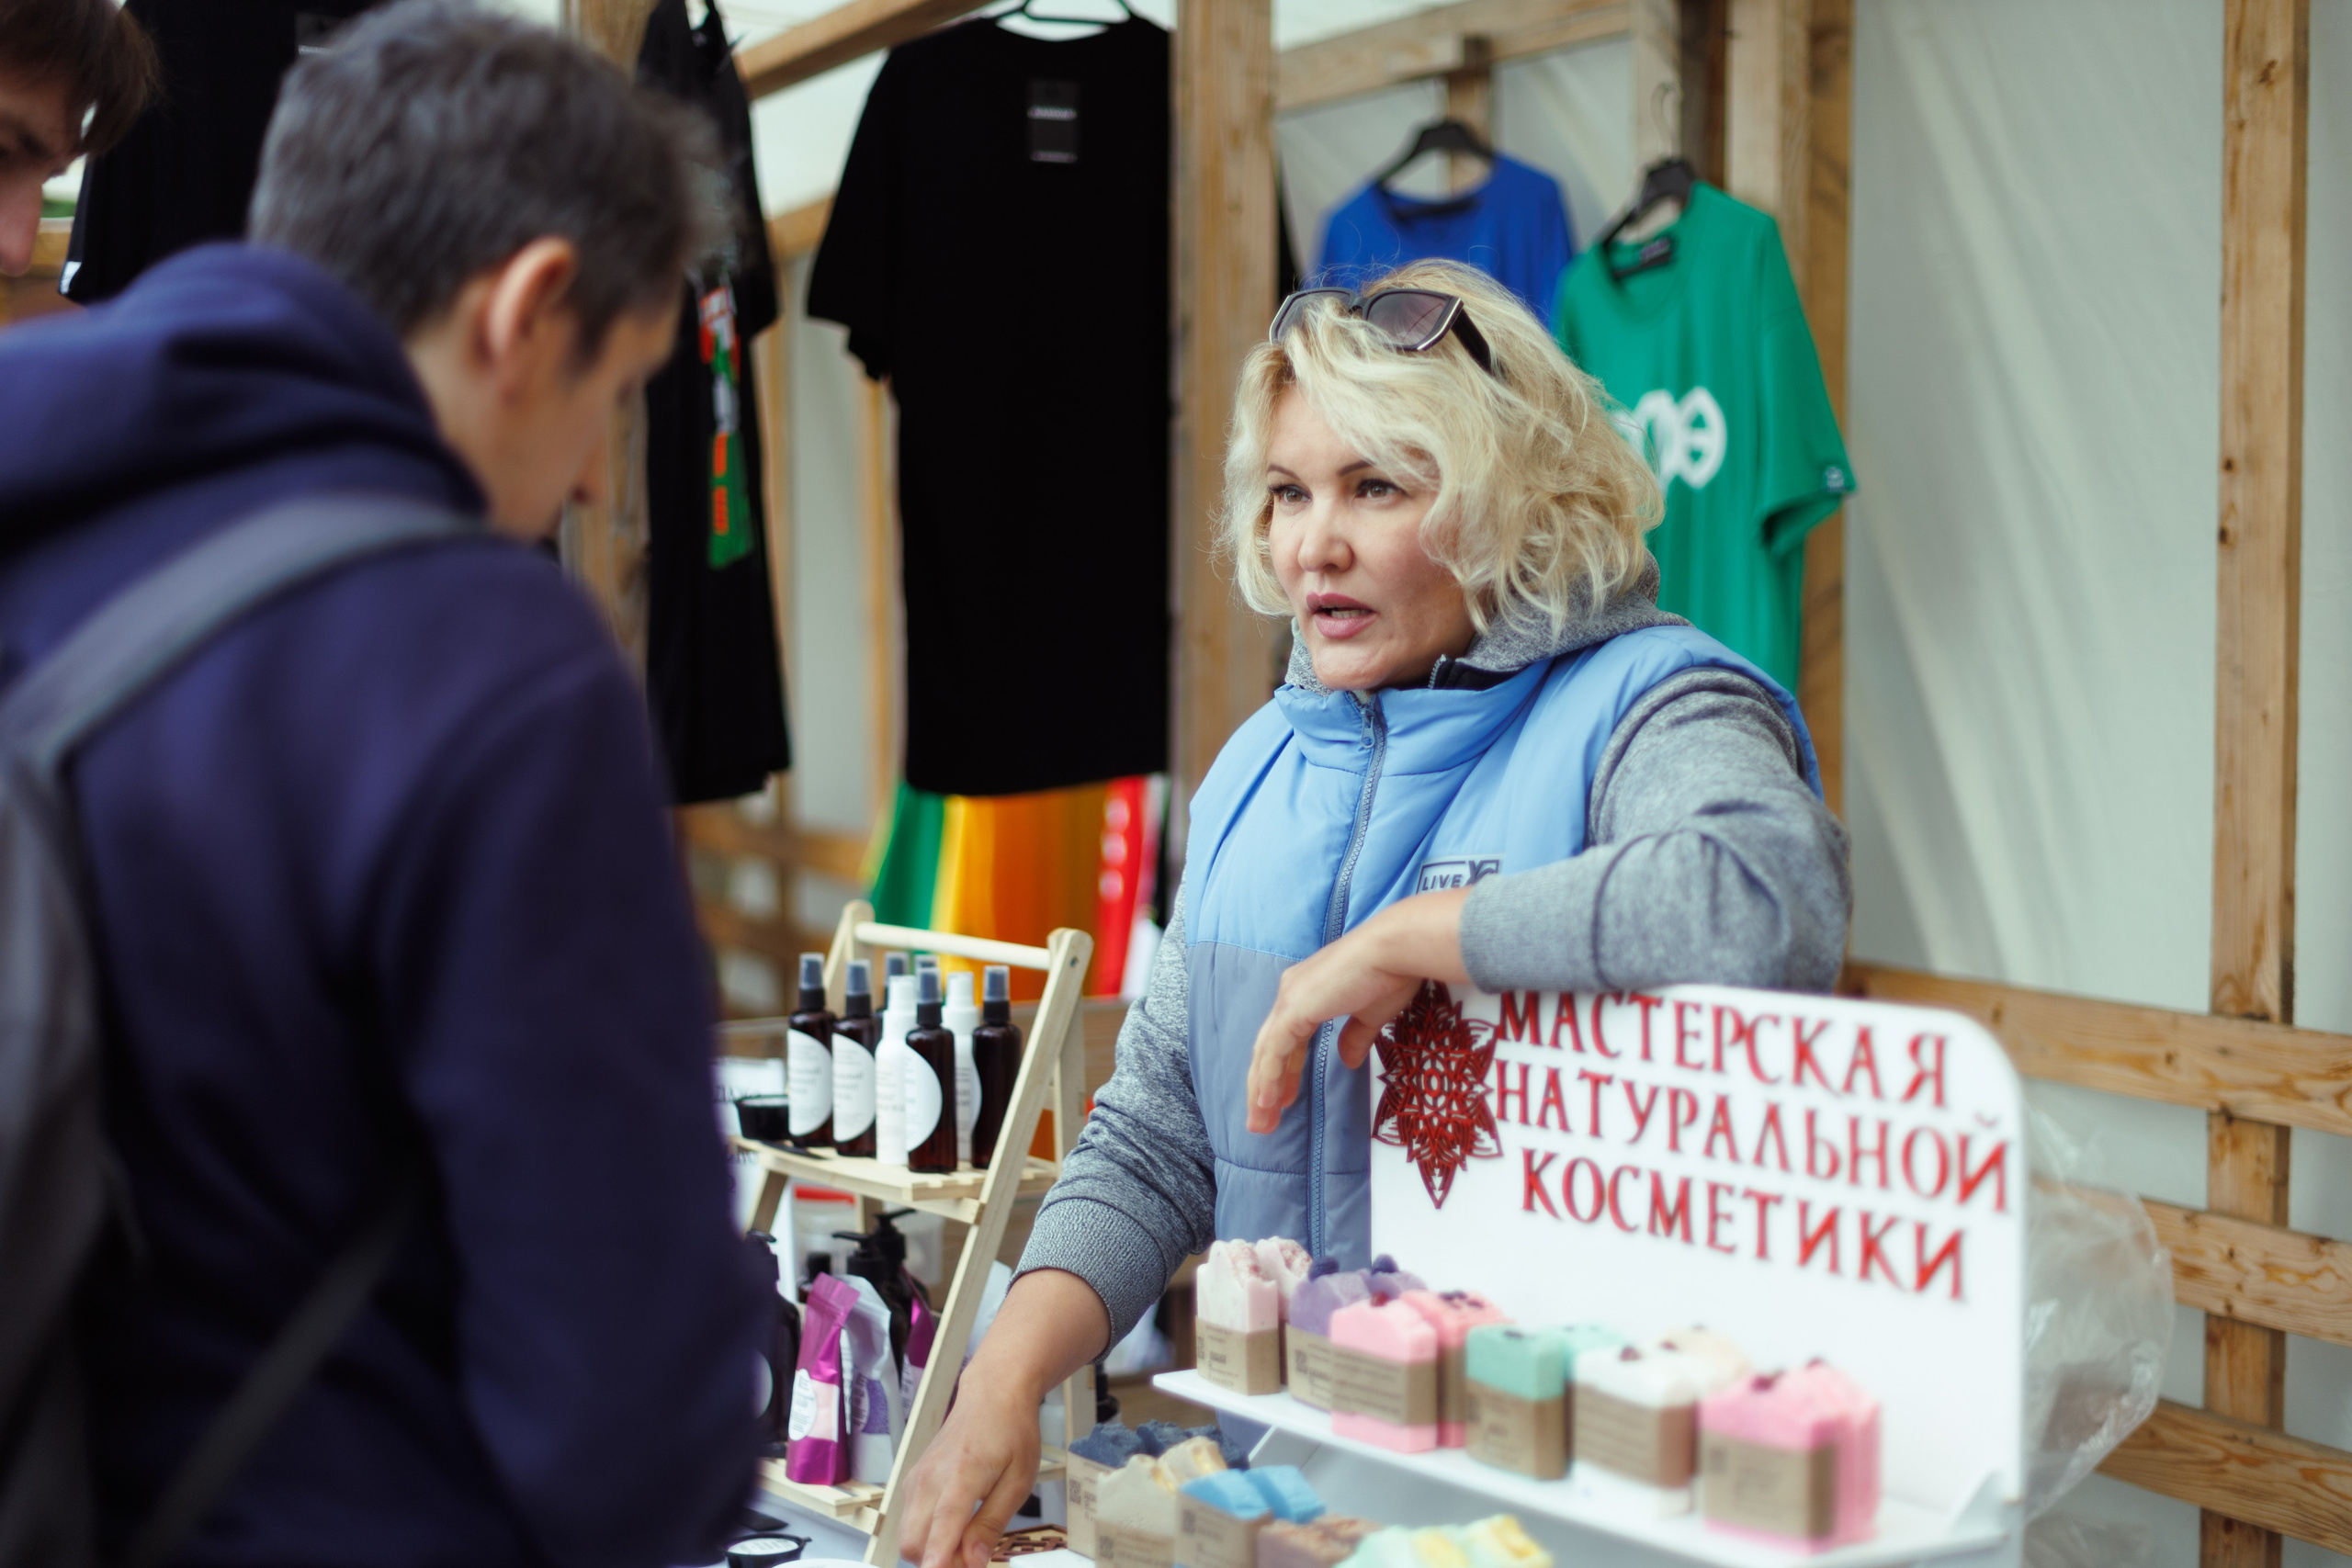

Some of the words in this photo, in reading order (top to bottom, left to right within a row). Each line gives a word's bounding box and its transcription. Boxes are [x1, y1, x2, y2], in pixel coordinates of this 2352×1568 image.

[1422, 874, 1463, 891] LIVE
[1497, 989, 1947, 1108] МАСТЕРСКАЯ
[1495, 1057, 2009, 1213] НАТУРАЛЬНОЙ
[1521, 1147, 1964, 1301] КОСМЕТИКИ
